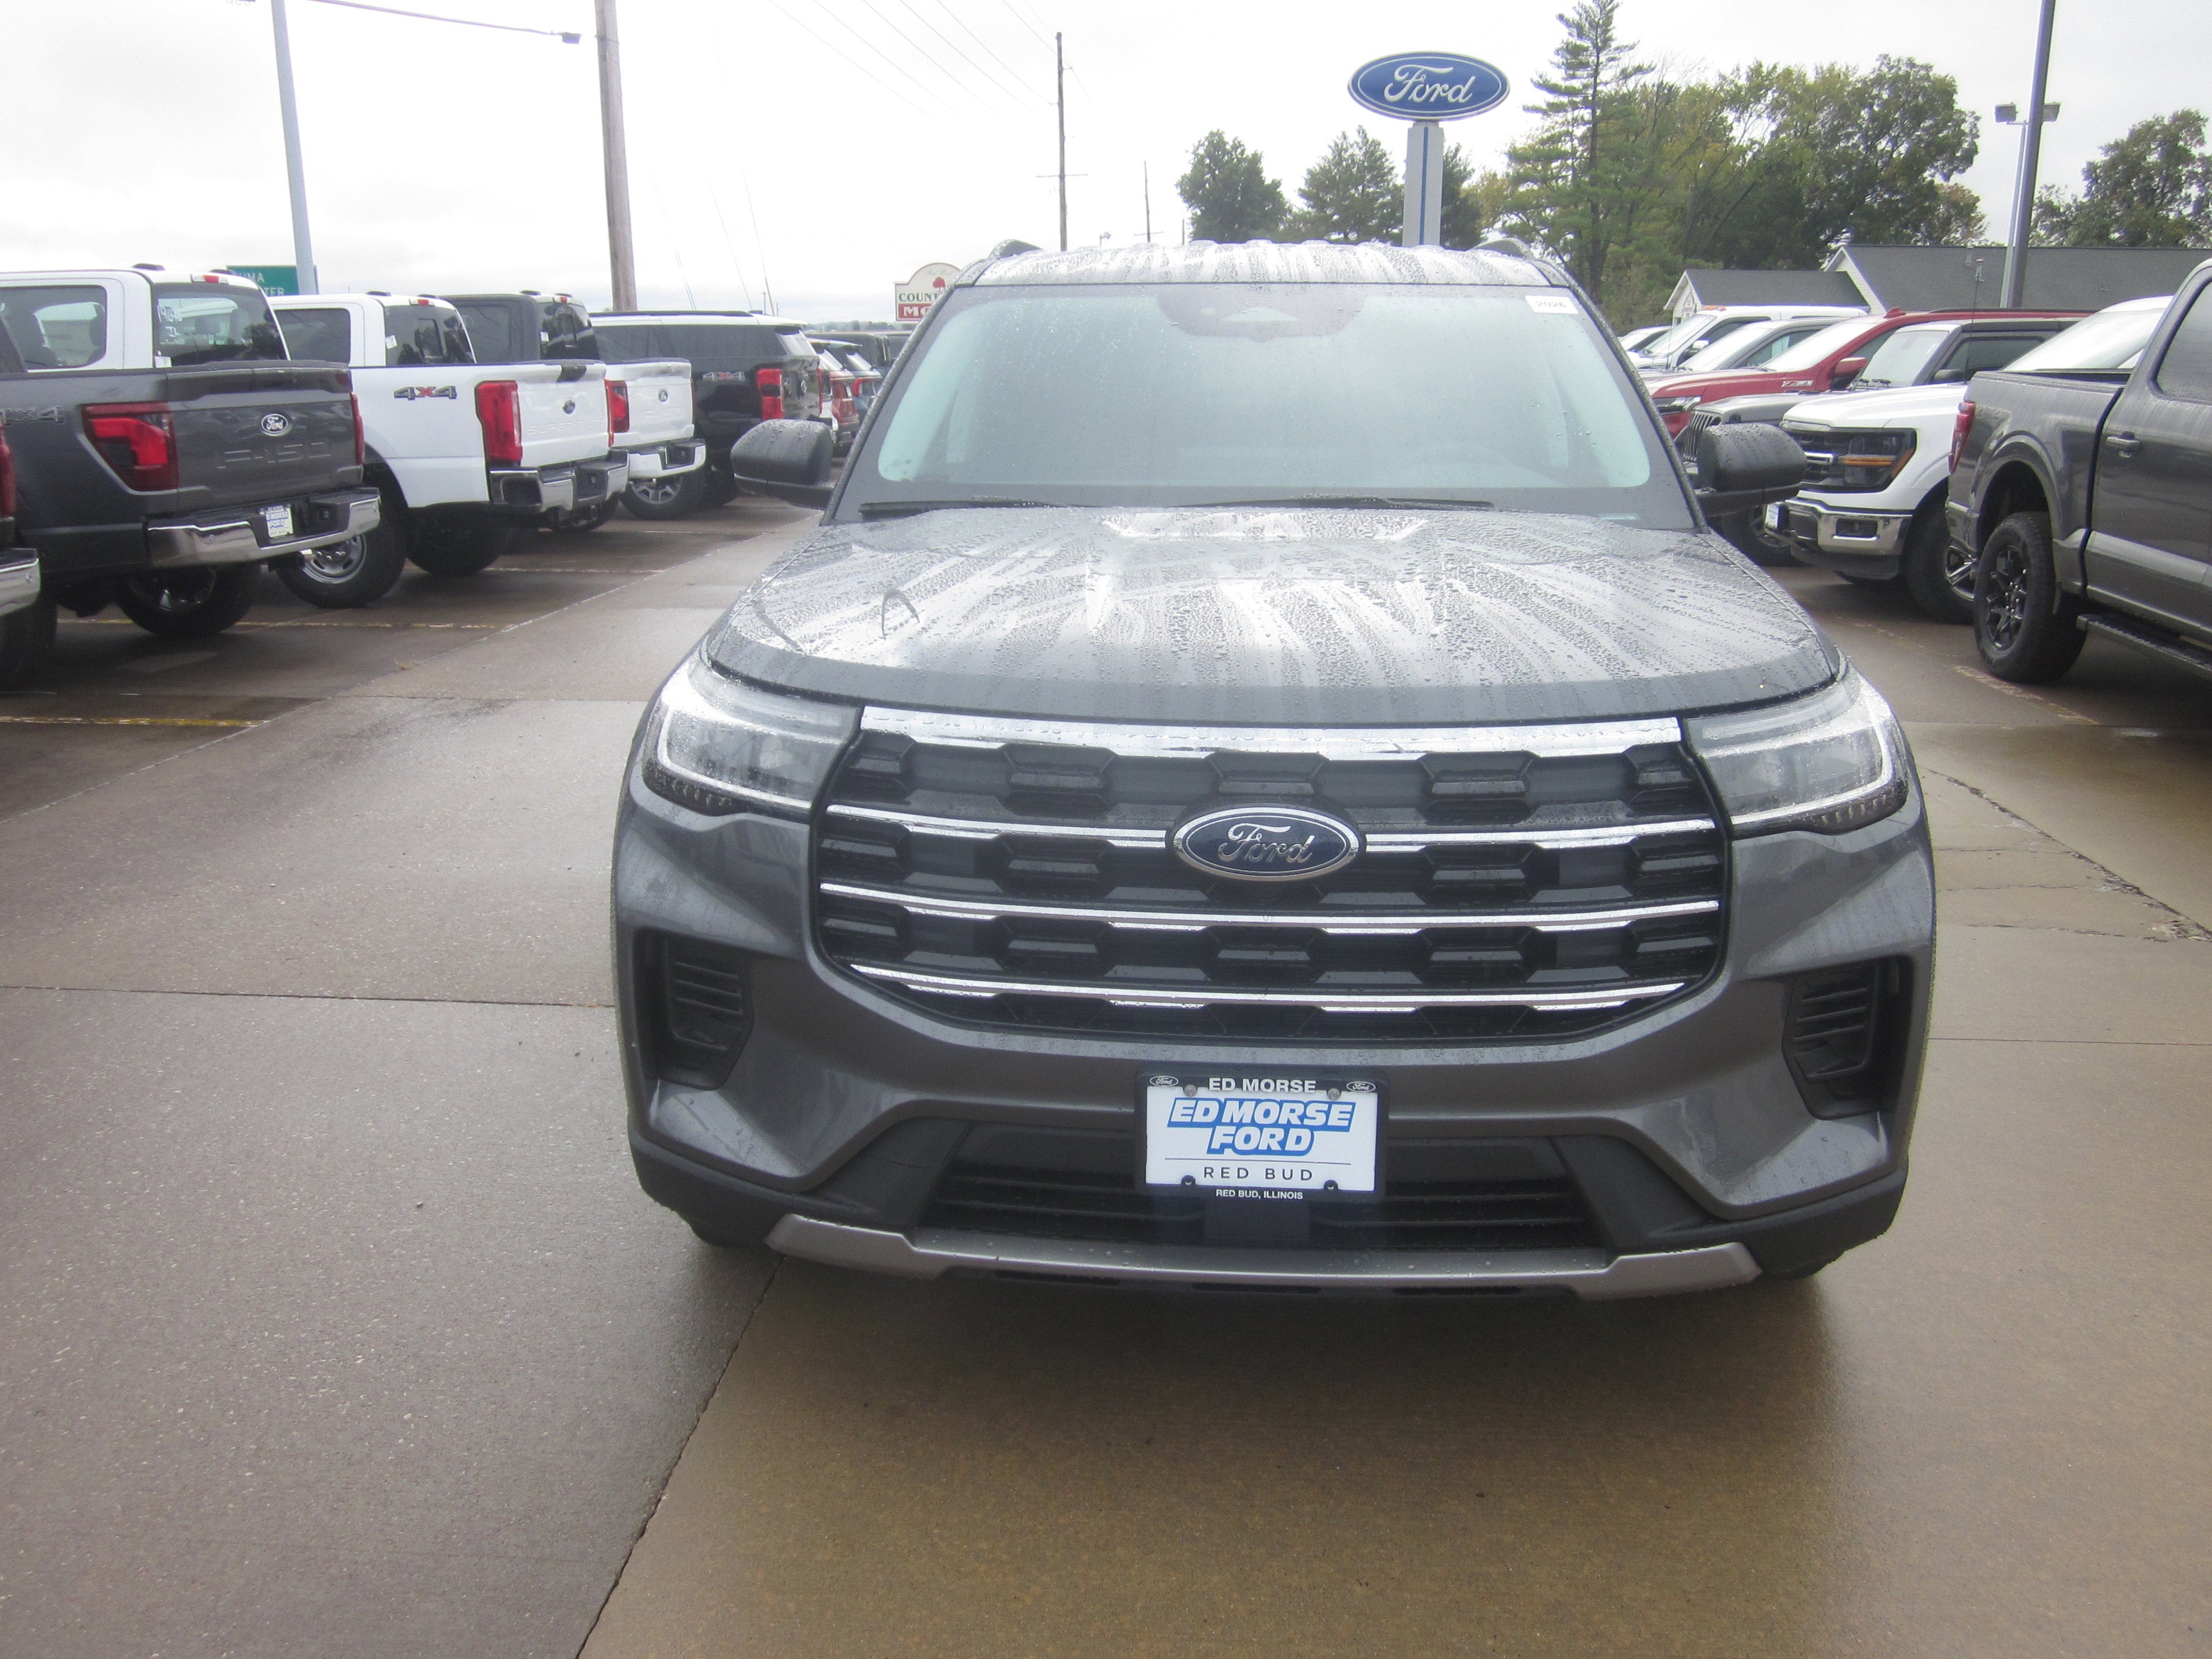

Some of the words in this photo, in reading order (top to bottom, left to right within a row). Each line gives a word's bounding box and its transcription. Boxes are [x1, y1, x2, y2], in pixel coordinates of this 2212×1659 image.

[1384, 64, 1476, 103] Ford
[267, 416, 284, 430] Ford
[1218, 823, 1316, 863] Ford
[1155, 1077, 1173, 1085] Ford
[1209, 1077, 1236, 1091] ED
[1242, 1078, 1317, 1093] MORSE
[1352, 1082, 1370, 1091] Ford
[1211, 1125, 1312, 1151] FORD
[1203, 1166, 1249, 1179] RED
[1265, 1168, 1313, 1181] BUD
[1215, 1189, 1236, 1197] RED
[1238, 1190, 1261, 1200] BUD,
[1263, 1191, 1303, 1199] ILLINOIS
